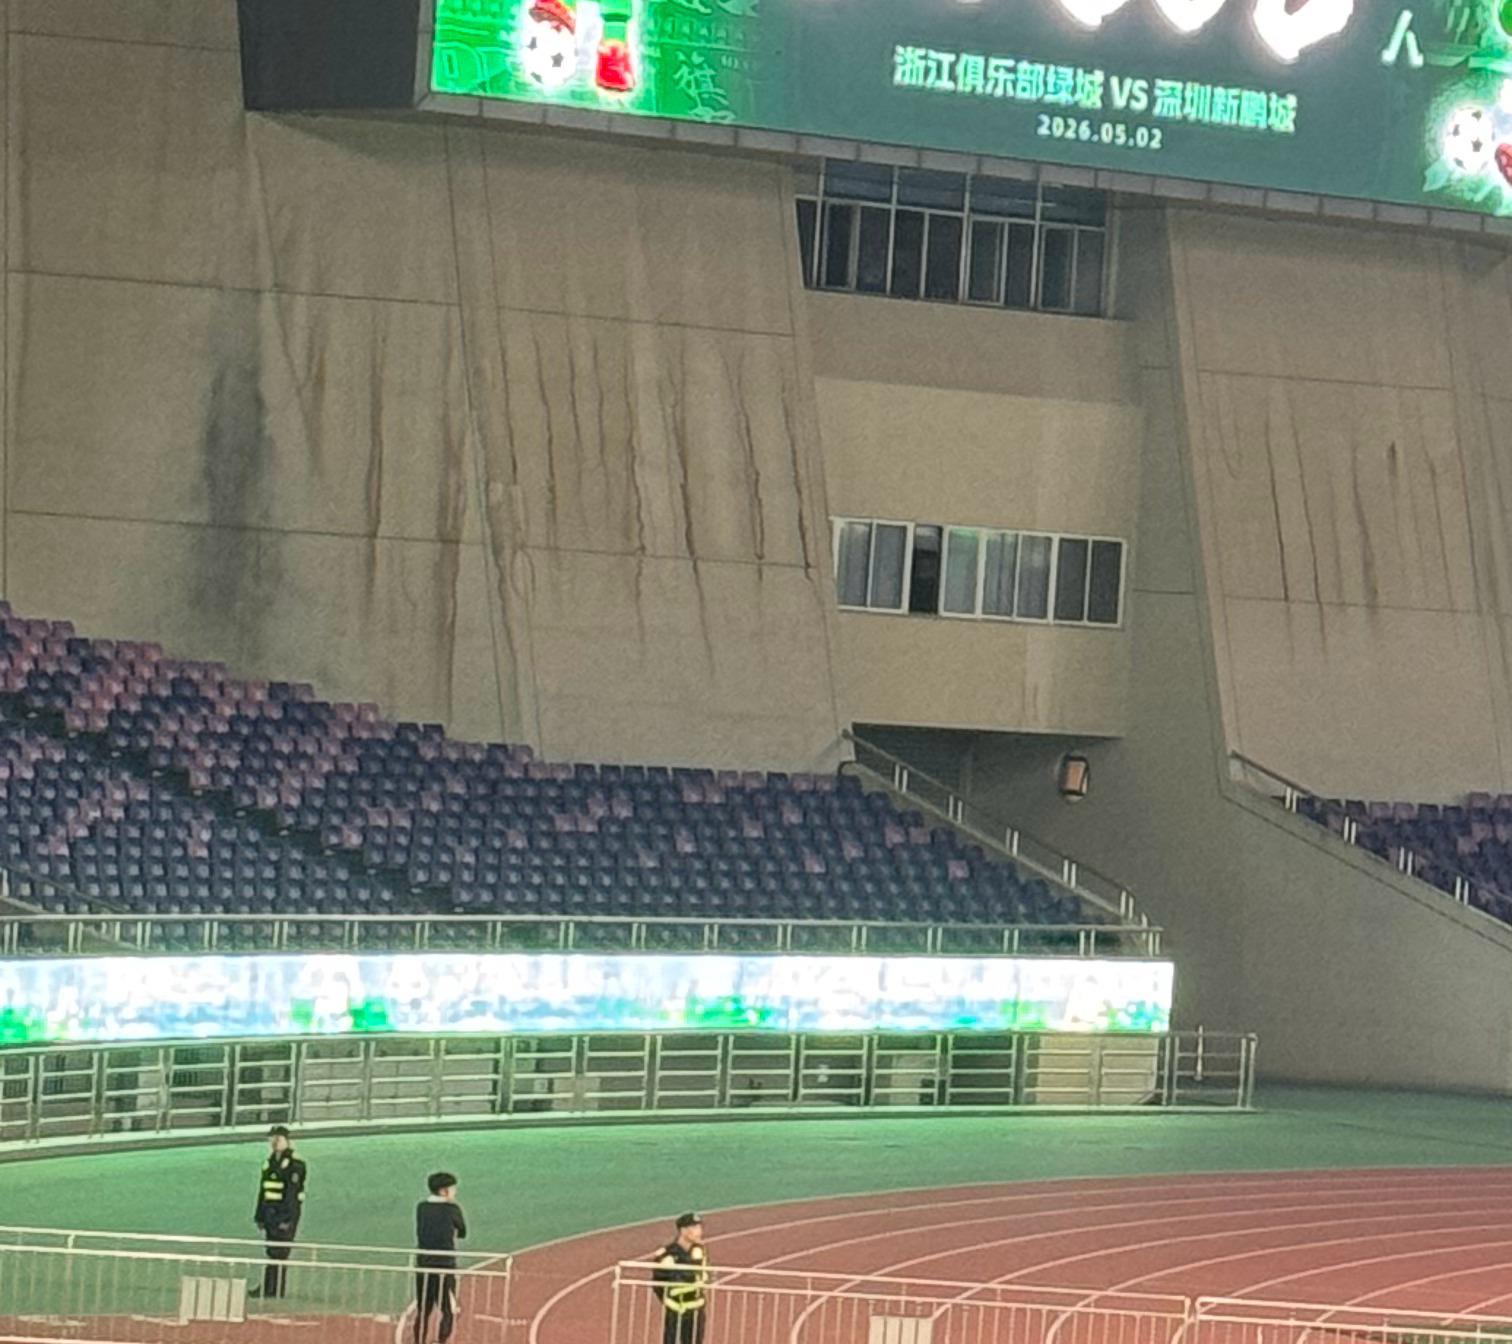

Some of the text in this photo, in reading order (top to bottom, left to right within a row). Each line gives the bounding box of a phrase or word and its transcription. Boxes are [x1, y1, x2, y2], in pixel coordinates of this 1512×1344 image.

[1381, 10, 1423, 66] 人
[892, 45, 1299, 134] 浙江俱乐部绿城 VS 深圳新鹏城
[1036, 113, 1163, 150] 2026.05.02
